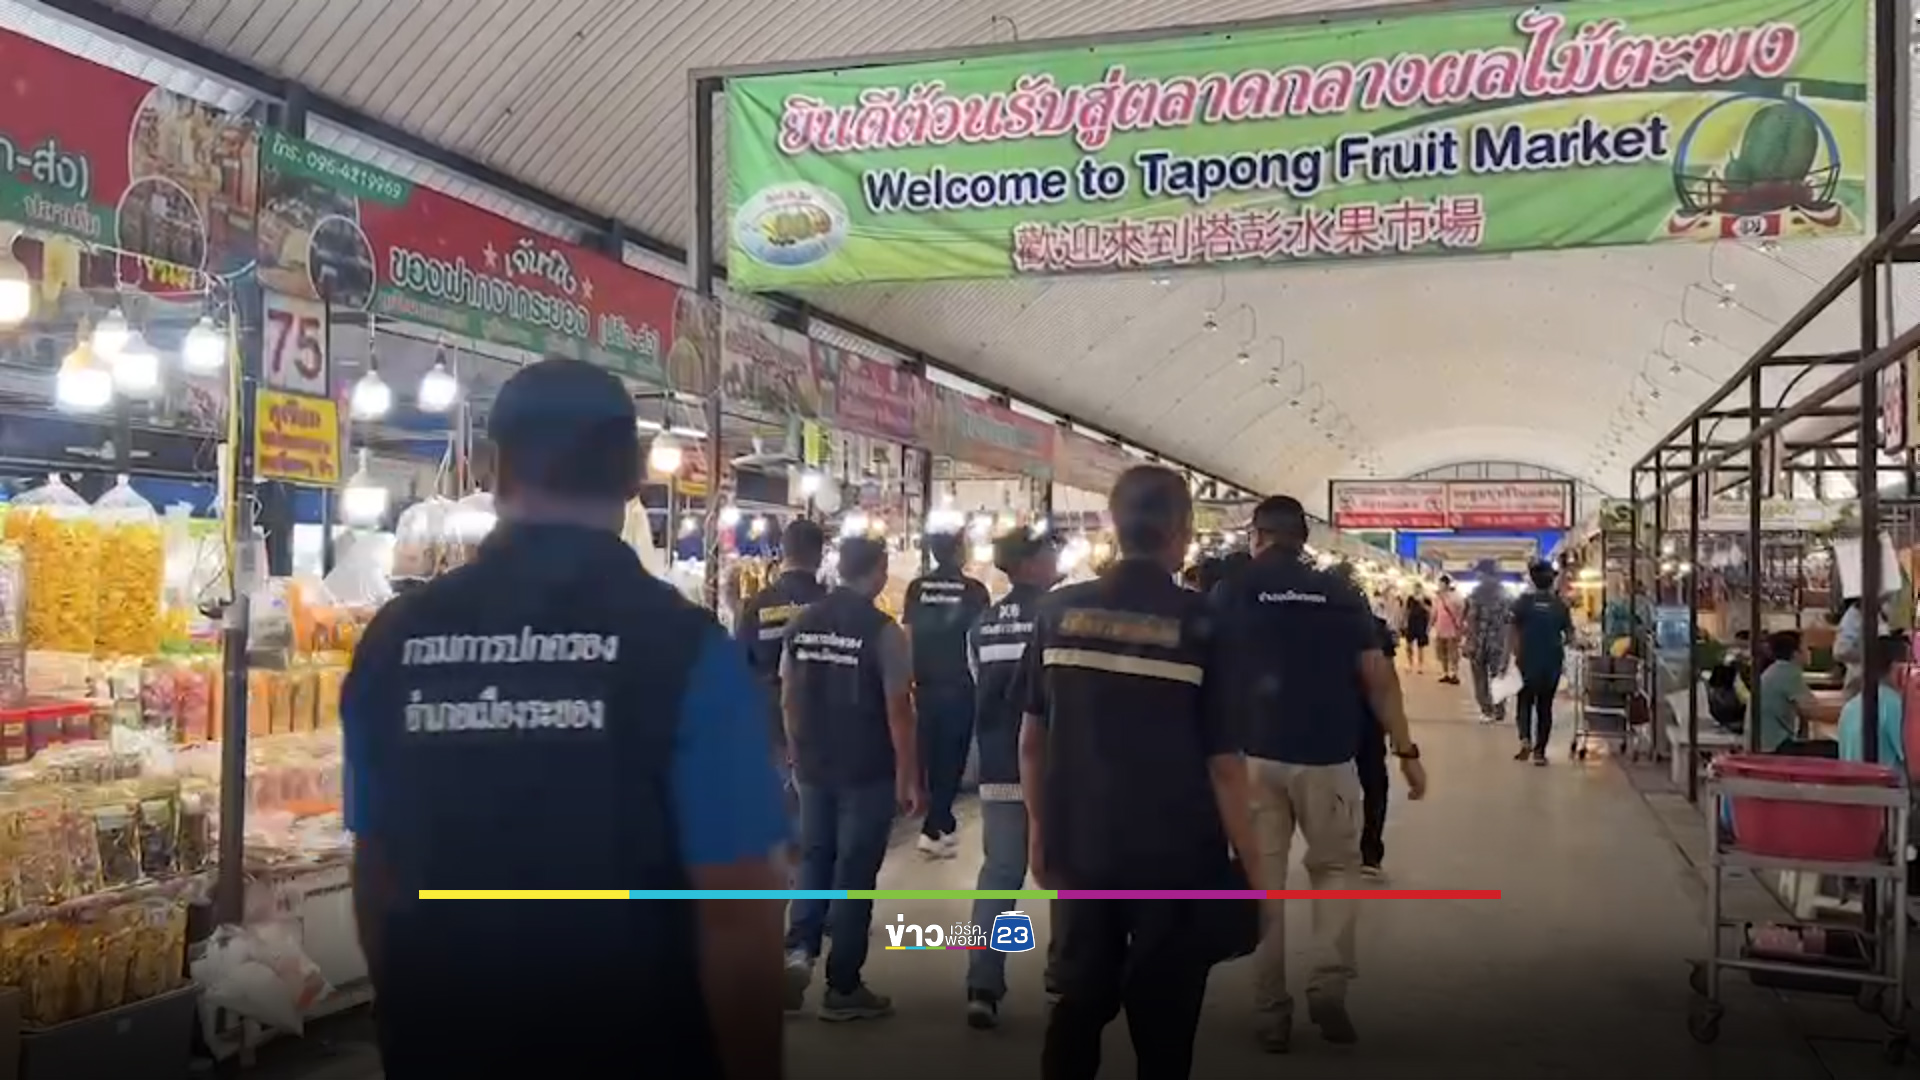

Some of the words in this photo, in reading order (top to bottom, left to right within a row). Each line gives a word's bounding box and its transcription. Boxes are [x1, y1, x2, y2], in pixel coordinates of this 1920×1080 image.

[782, 13, 1797, 152] ยินดีต้อนรับสู่ตลาดกลางผลไม้ตะพง
[867, 169, 1066, 210] Welcome
[1079, 159, 1125, 196] to
[1138, 150, 1322, 201] Tapong
[1338, 130, 1458, 182] Fruit
[1475, 115, 1669, 171] Market
[1014, 198, 1484, 271] 歡迎來到塔彭水果市場
[389, 246, 591, 337] ของฝากจากระยอง
[267, 308, 323, 380] 75
[401, 625, 618, 665] กรมการปกครอง
